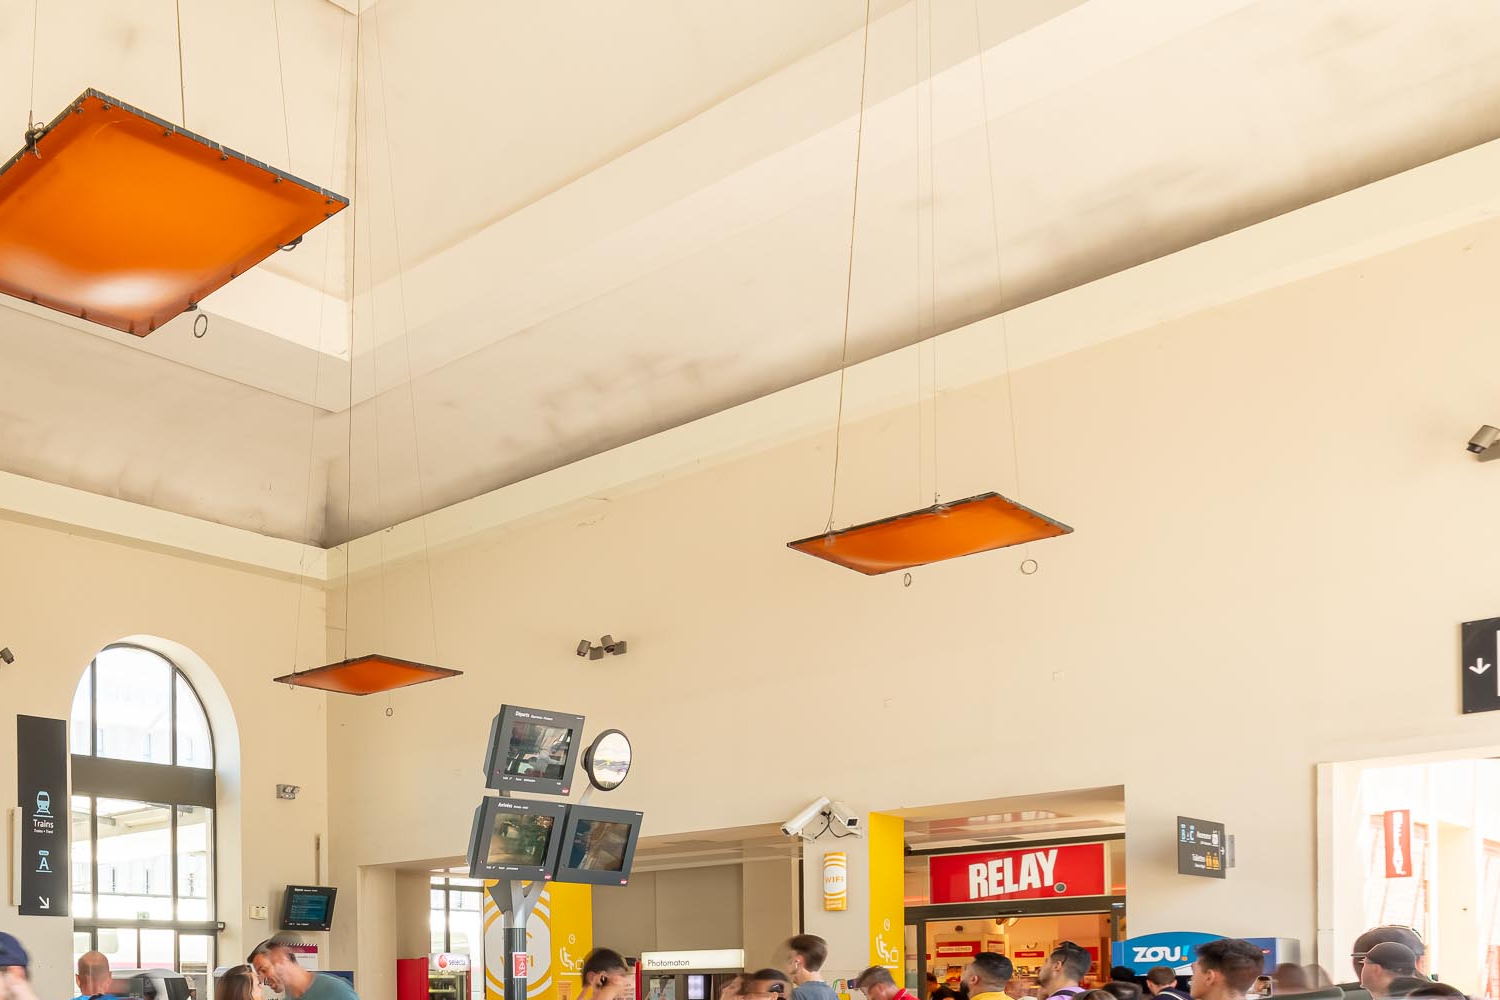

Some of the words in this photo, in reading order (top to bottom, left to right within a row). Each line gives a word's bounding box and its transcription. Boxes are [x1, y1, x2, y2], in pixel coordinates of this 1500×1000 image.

[33, 819, 54, 828] Trains
[39, 857, 49, 870] A
[968, 849, 1058, 900] RELAY
